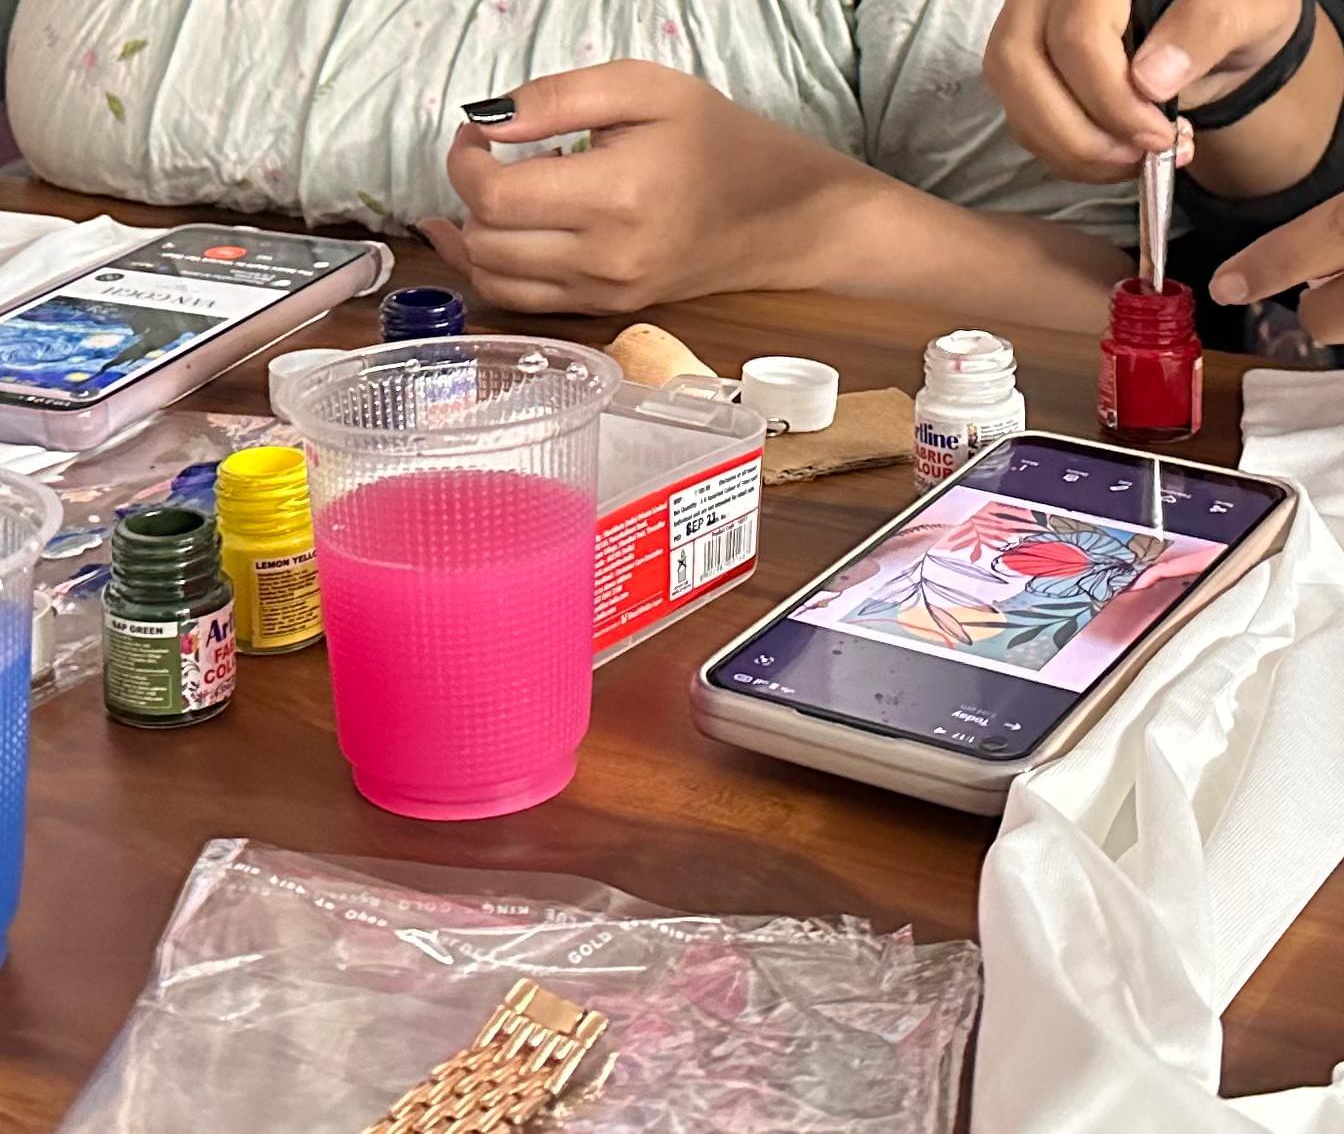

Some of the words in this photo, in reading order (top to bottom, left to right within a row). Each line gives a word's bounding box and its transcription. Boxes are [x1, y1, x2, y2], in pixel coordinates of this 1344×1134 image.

[914, 422, 960, 451] rtline
[914, 446, 954, 465] ABRIC
[256, 558, 290, 569] LEMON
[292, 549, 317, 565] YELLO
[129, 625, 163, 635] GREEN
[951, 710, 989, 727] Today
[567, 931, 613, 964] GOLD
